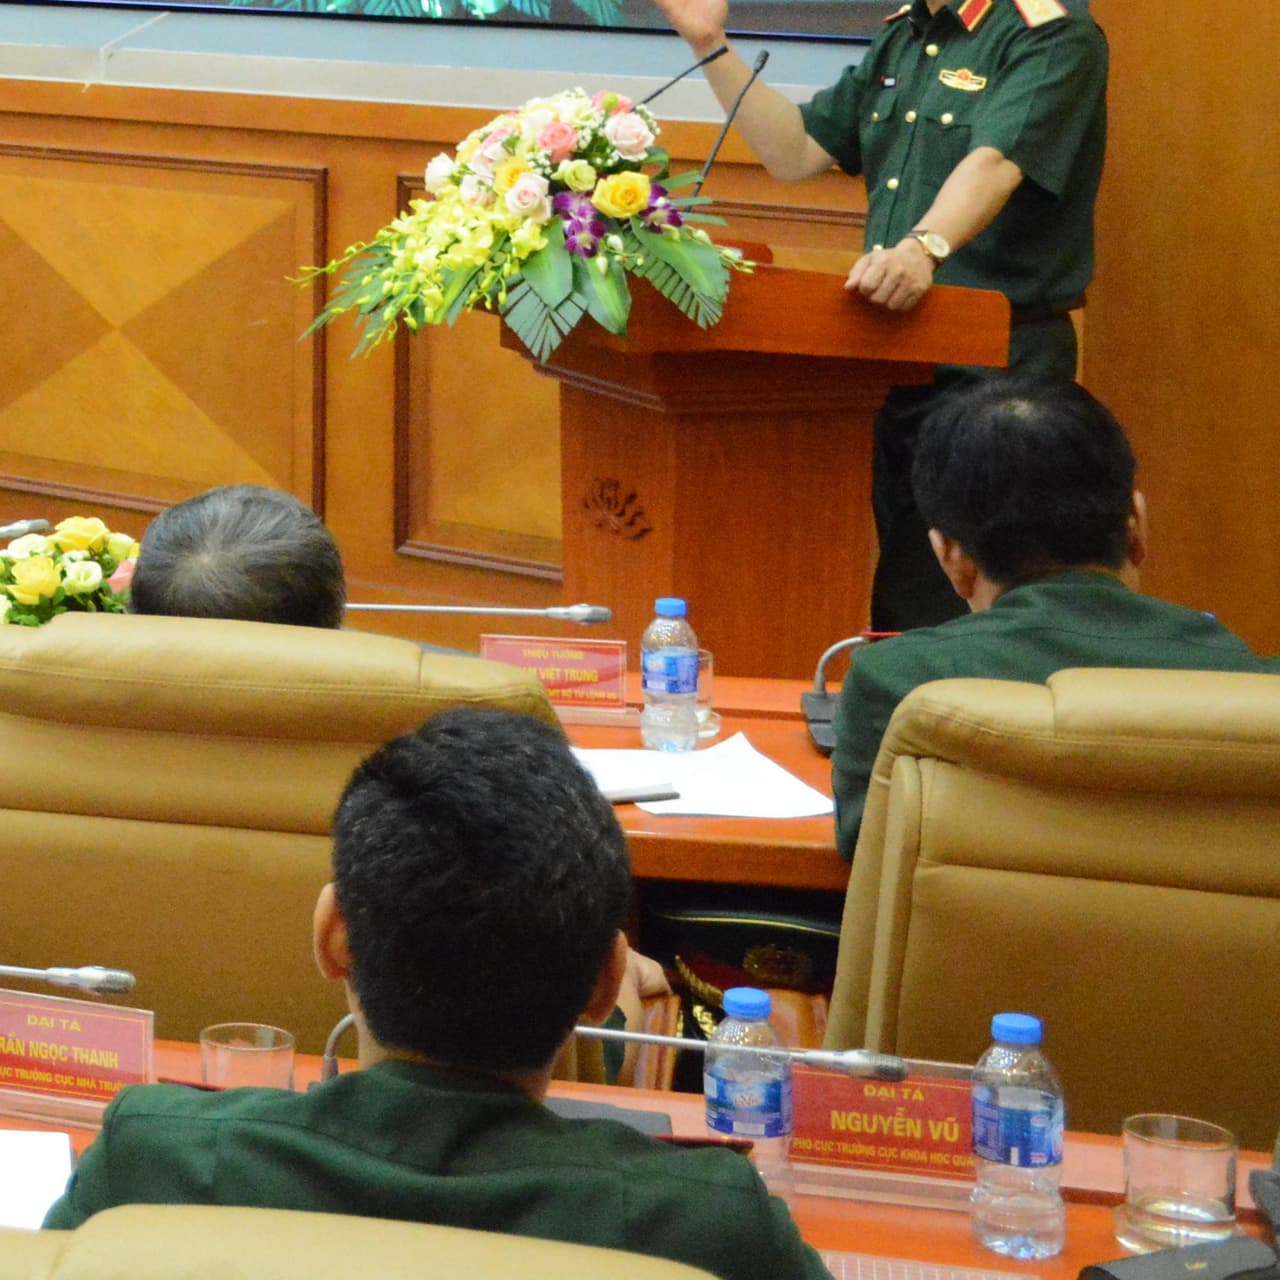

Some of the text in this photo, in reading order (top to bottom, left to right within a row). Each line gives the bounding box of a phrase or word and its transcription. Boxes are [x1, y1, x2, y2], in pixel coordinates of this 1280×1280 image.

[29, 1040, 69, 1066] NGỌC
[72, 1046, 119, 1069] THANH
[863, 1084, 924, 1102] ĐẠI TÁ
[831, 1106, 960, 1143] NGUYỄN VŨ
